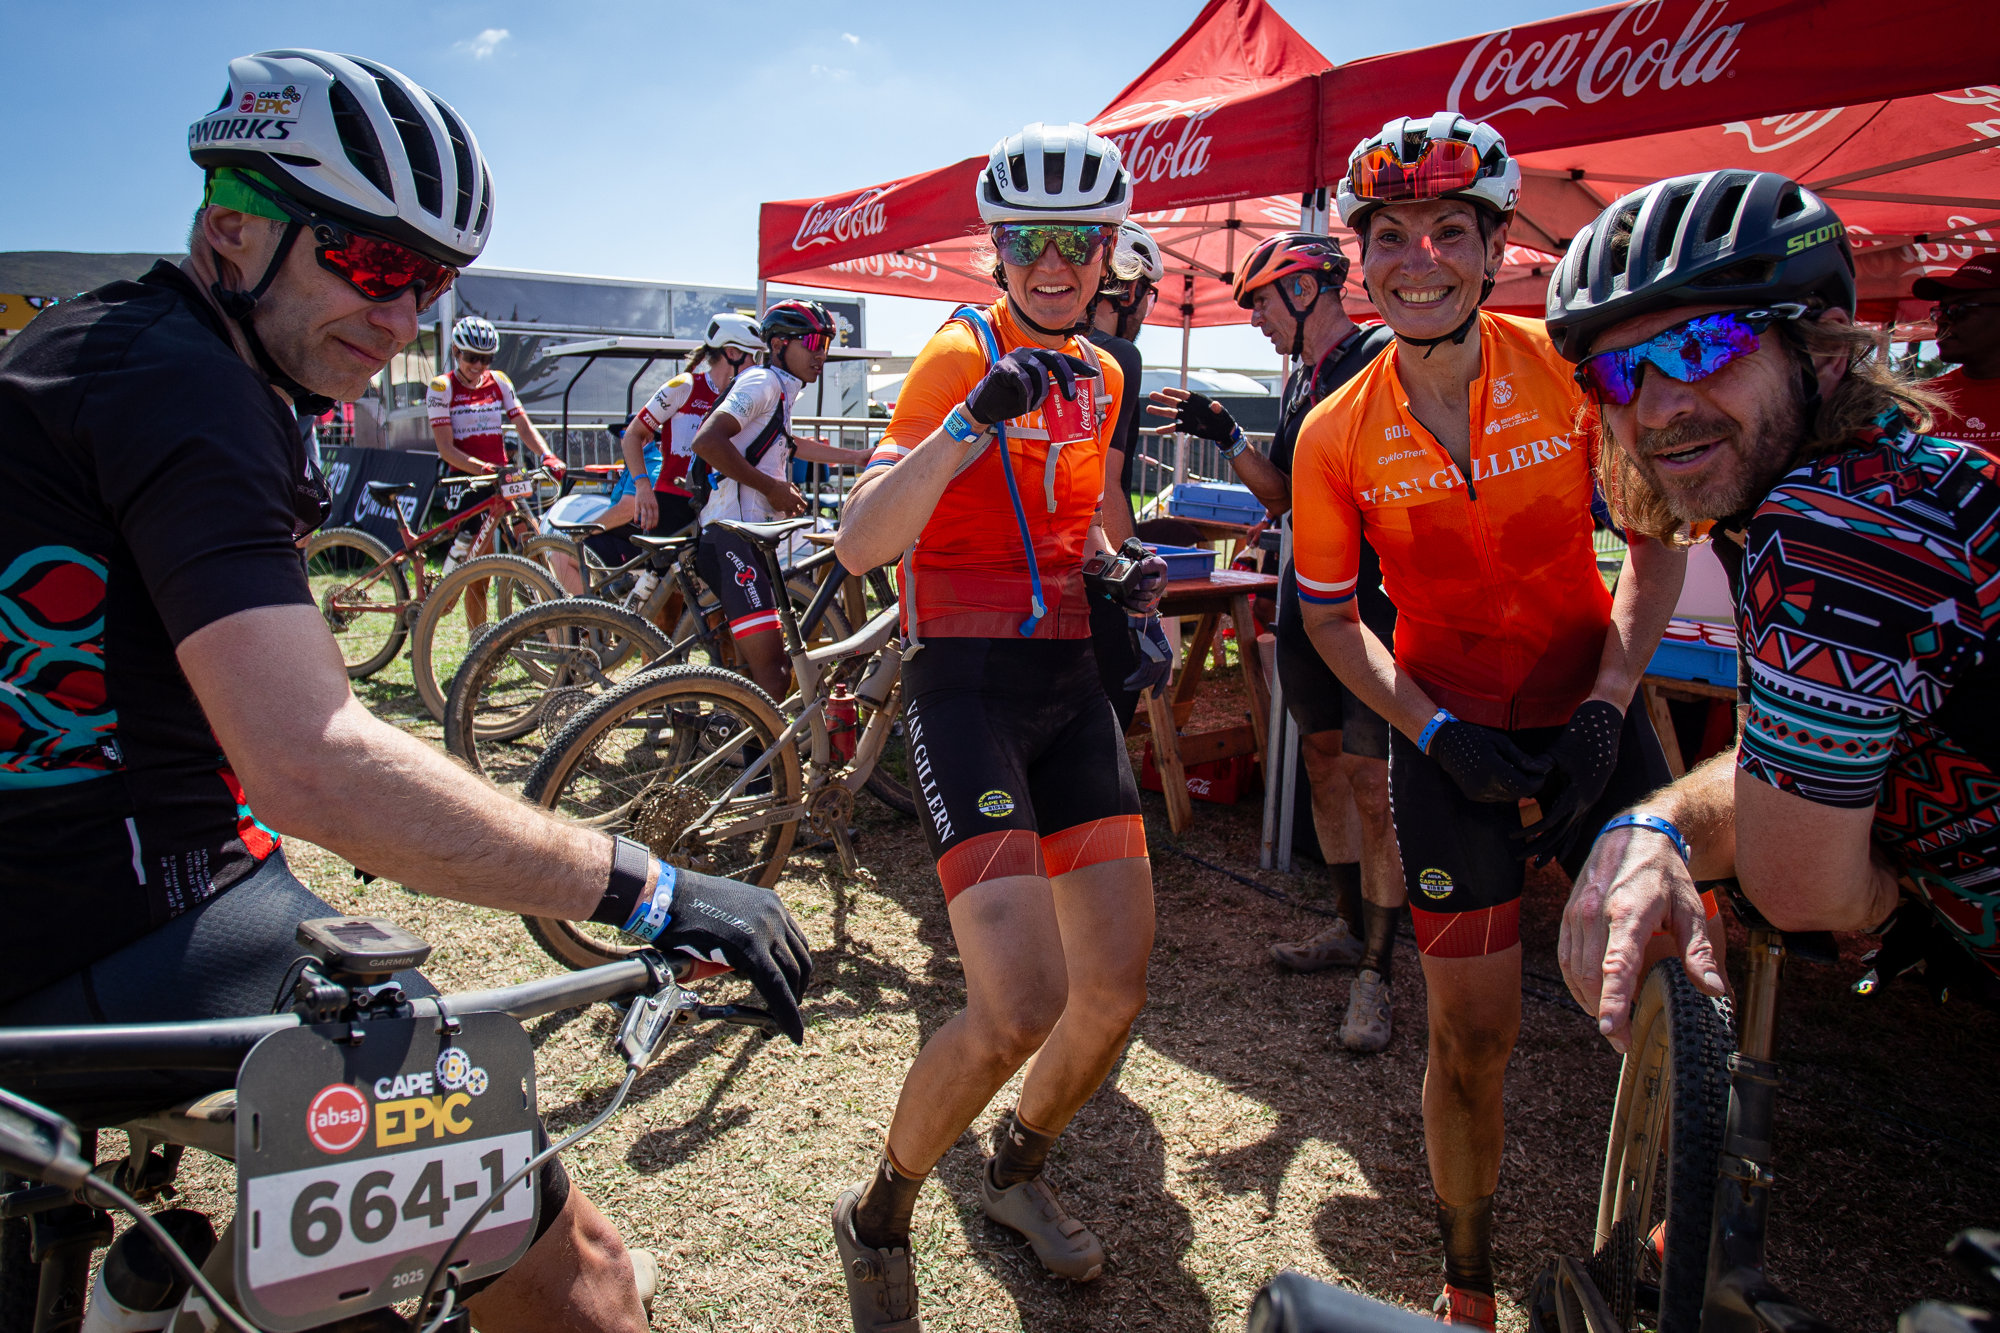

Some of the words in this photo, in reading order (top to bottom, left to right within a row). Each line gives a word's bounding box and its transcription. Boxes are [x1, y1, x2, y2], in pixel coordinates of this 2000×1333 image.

[254, 98, 292, 114] EPIC
[258, 91, 282, 99] CAPE
[190, 119, 298, 143] -WORKS
[791, 183, 900, 251] Coca-Cola
[1077, 386, 1092, 431] Coca-Cola
[1384, 424, 1412, 441] GOB
[1360, 478, 1423, 505] VAN
[1429, 432, 1573, 490] GILLERN
[1378, 448, 1428, 466] CykloTren
[509, 483, 527, 494] 62-1
[906, 699, 924, 746] VAN
[914, 744, 955, 843] GILLERN
[369, 957, 415, 968] GARMIN
[374, 1072, 434, 1100] CAPE
[316, 1109, 362, 1128] absa
[375, 1092, 473, 1149] EPIC
[290, 1148, 505, 1258] 664-1
[392, 1269, 425, 1289] 2025
